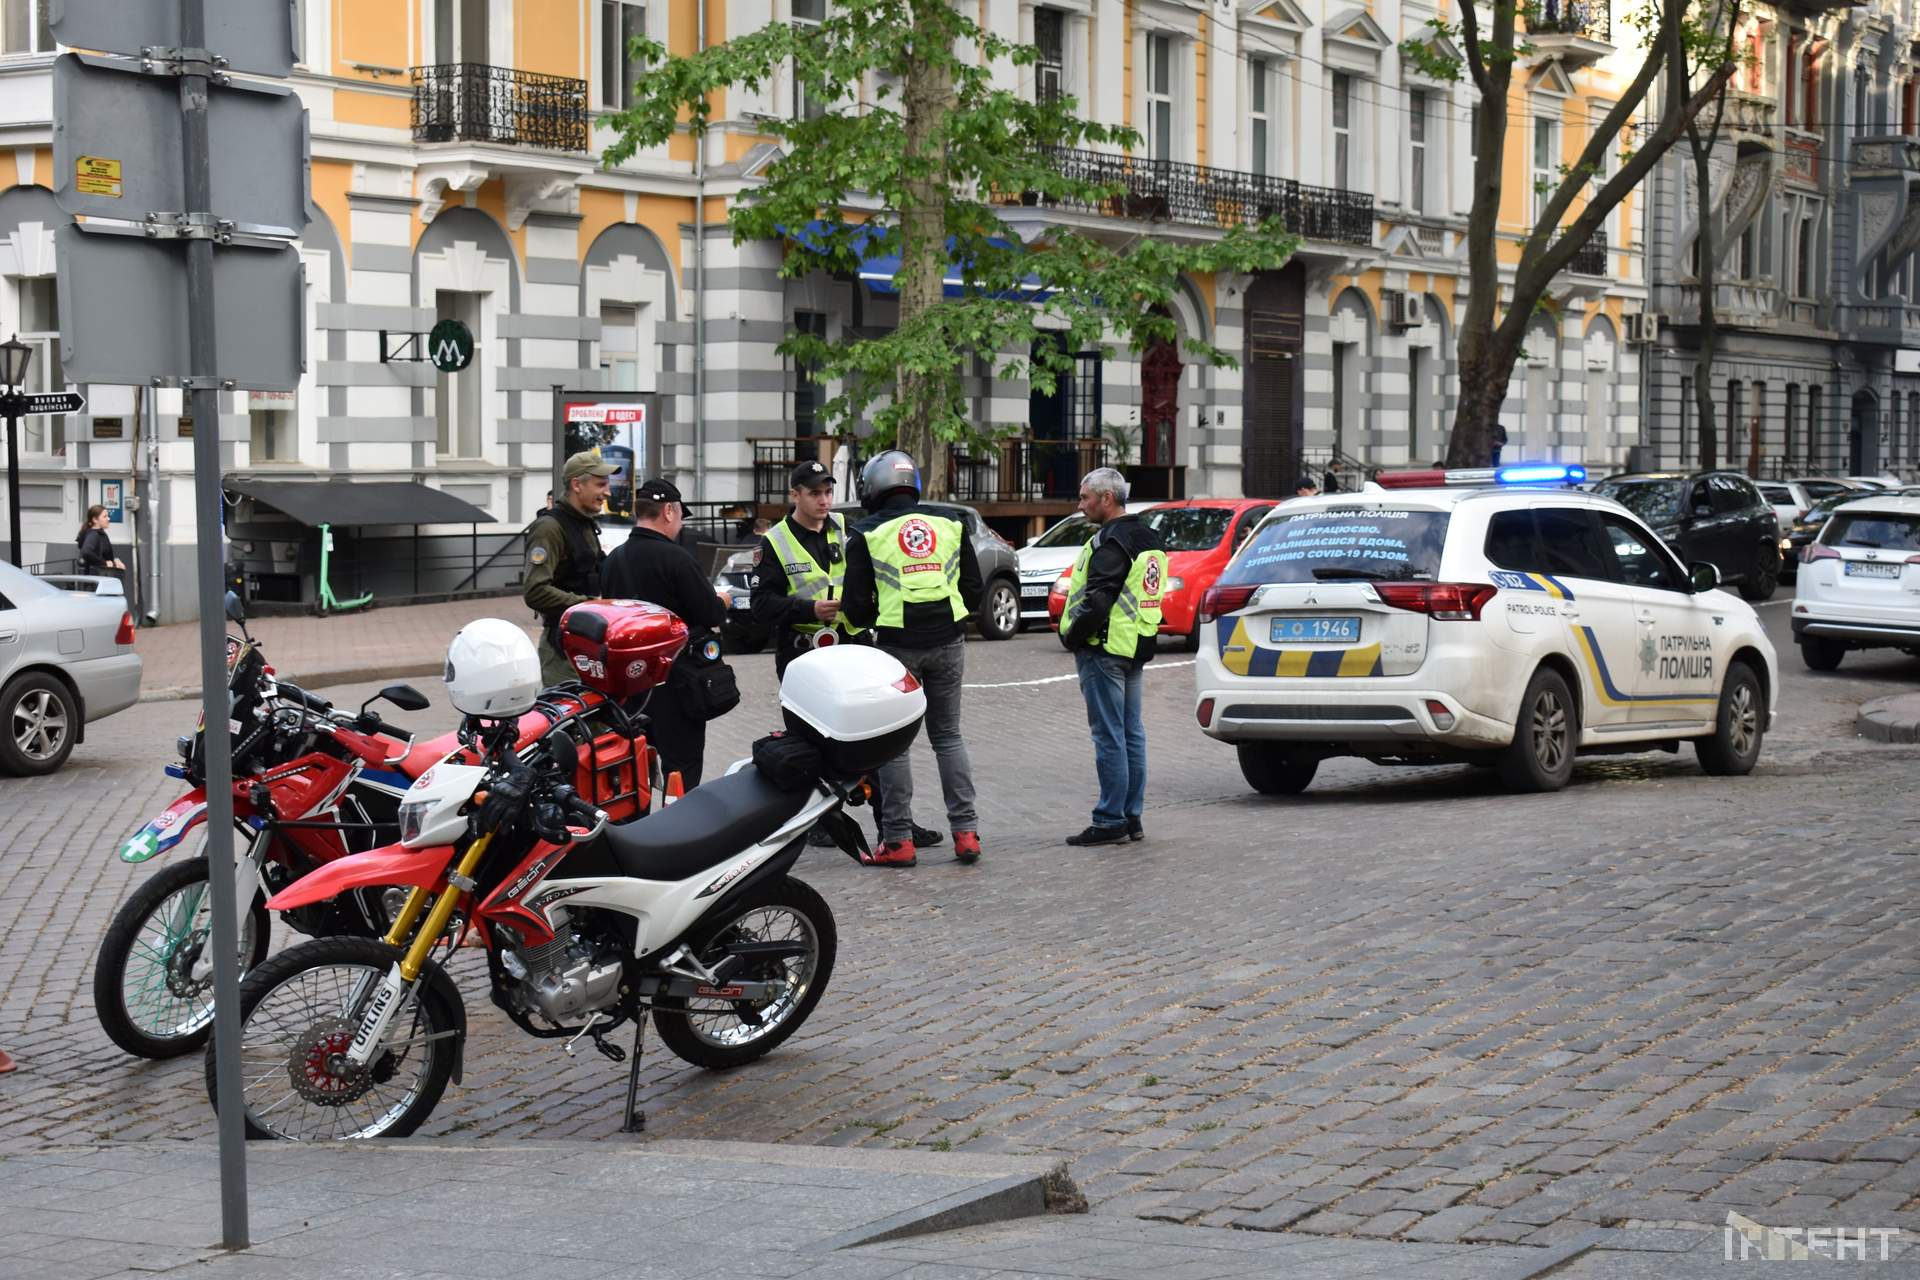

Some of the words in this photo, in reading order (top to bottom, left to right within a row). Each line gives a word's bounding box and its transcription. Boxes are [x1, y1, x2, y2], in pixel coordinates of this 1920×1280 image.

[1289, 511, 1356, 523] ПАТРУЛЬНА
[1358, 510, 1409, 519] ПОЛІЦІЯ
[1287, 528, 1306, 538] МИ
[1306, 525, 1381, 536] ПРАЦЮЄМО.
[1257, 544, 1272, 554] ТИ
[1272, 537, 1356, 551] ЗАЛИШАЄШСЯ
[1358, 537, 1407, 549] ВДОМА.
[1245, 550, 1305, 568] ЗУПИНИМО
[1306, 549, 1361, 559] COVID-19
[1362, 549, 1409, 562] РАЗОМ.
[1507, 603, 1533, 615] PATROL
[1534, 605, 1557, 616] POLICE
[1312, 620, 1350, 636] 1946
[1661, 635, 1712, 651] ПАТРУЛЬНА
[1660, 656, 1712, 679] ПОЛІЦІЯ
